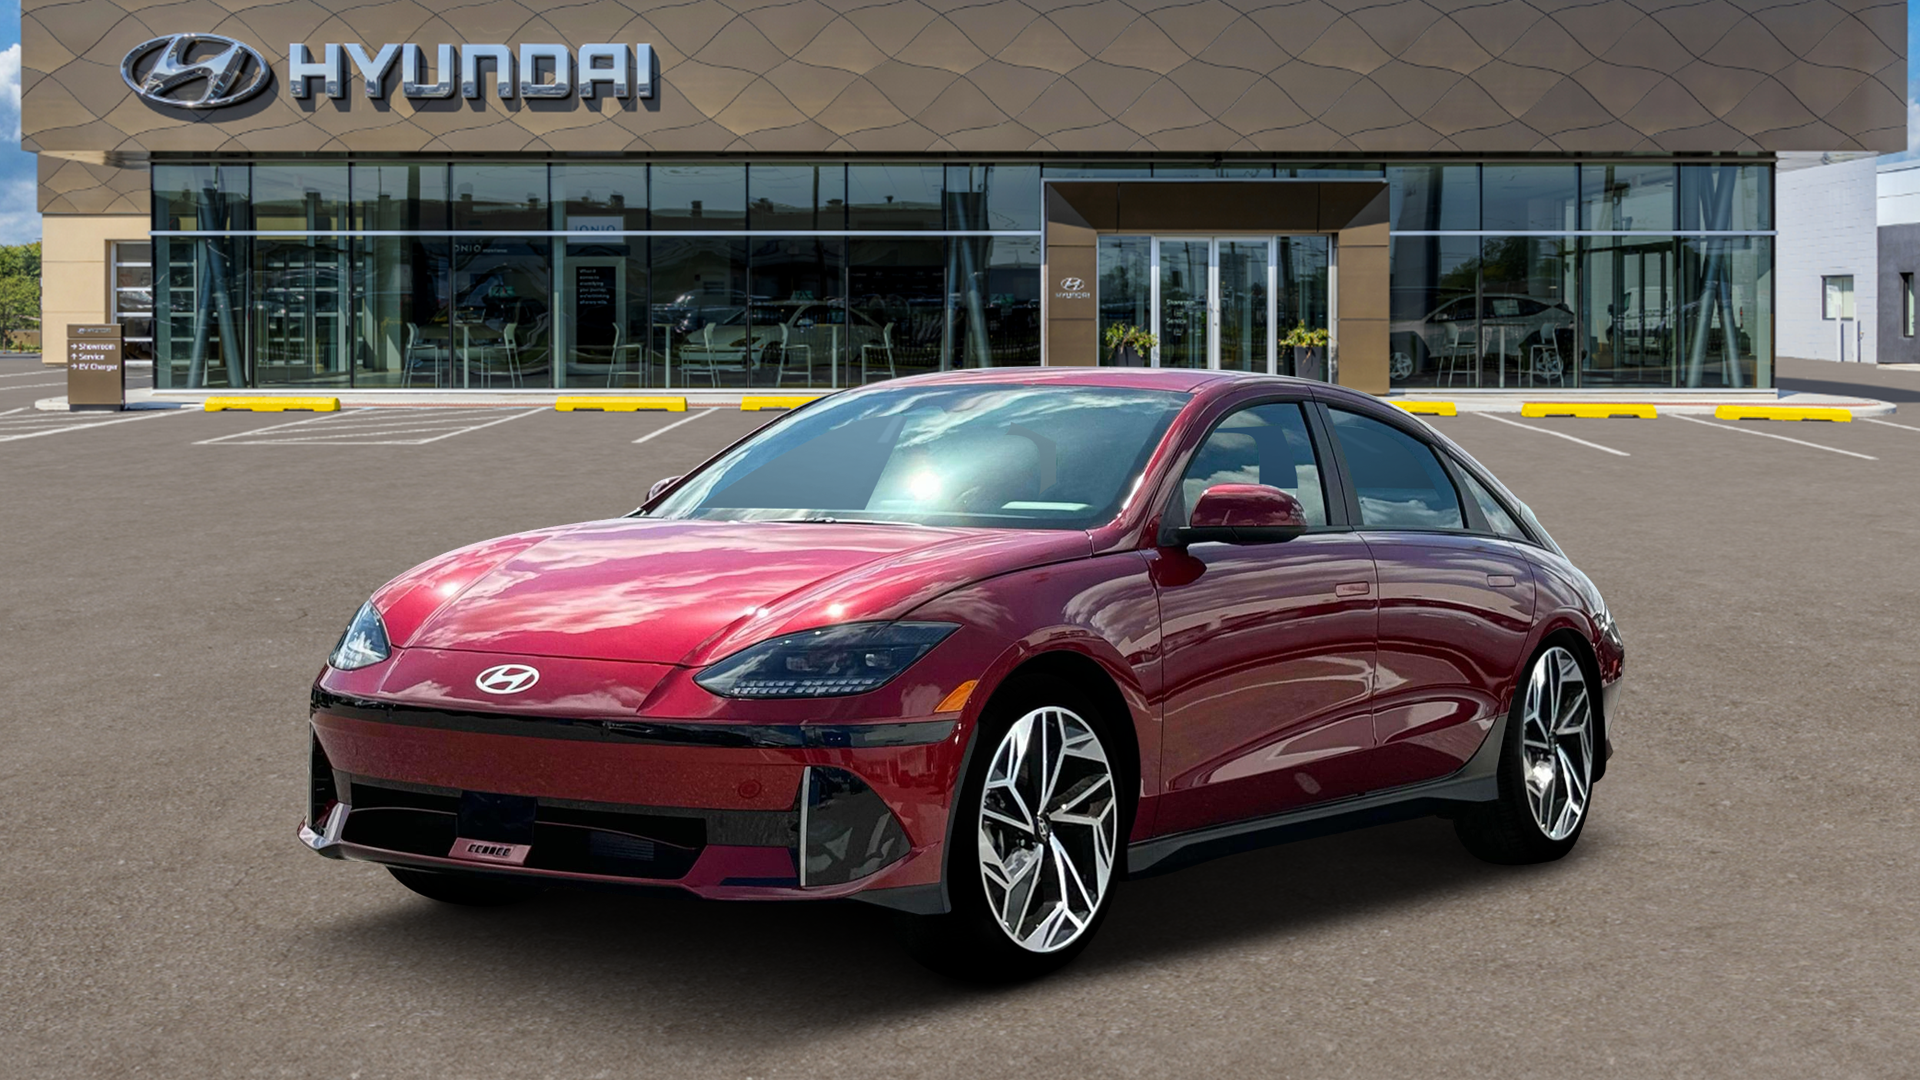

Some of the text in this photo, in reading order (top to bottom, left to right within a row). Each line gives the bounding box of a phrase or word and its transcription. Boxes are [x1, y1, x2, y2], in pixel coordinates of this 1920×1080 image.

[289, 42, 654, 99] HYUNDAI
[78, 352, 105, 360] Service
[90, 363, 118, 372] Charger
